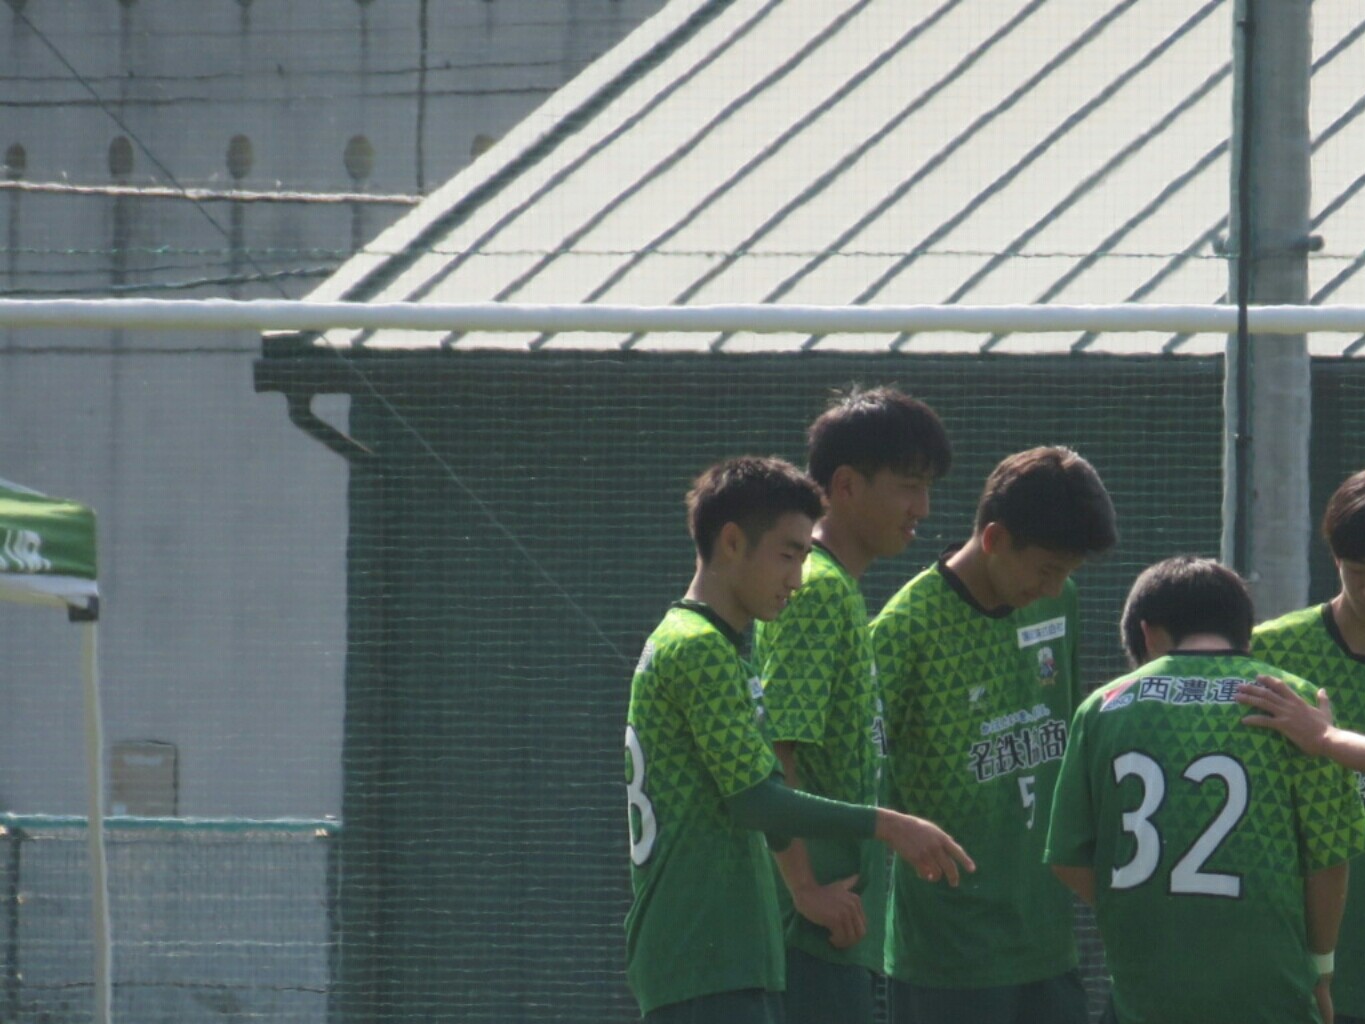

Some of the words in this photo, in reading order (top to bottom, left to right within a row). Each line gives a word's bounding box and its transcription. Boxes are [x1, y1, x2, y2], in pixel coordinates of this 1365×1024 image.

[1138, 676, 1262, 704] 西濃運
[1110, 751, 1248, 899] 32
